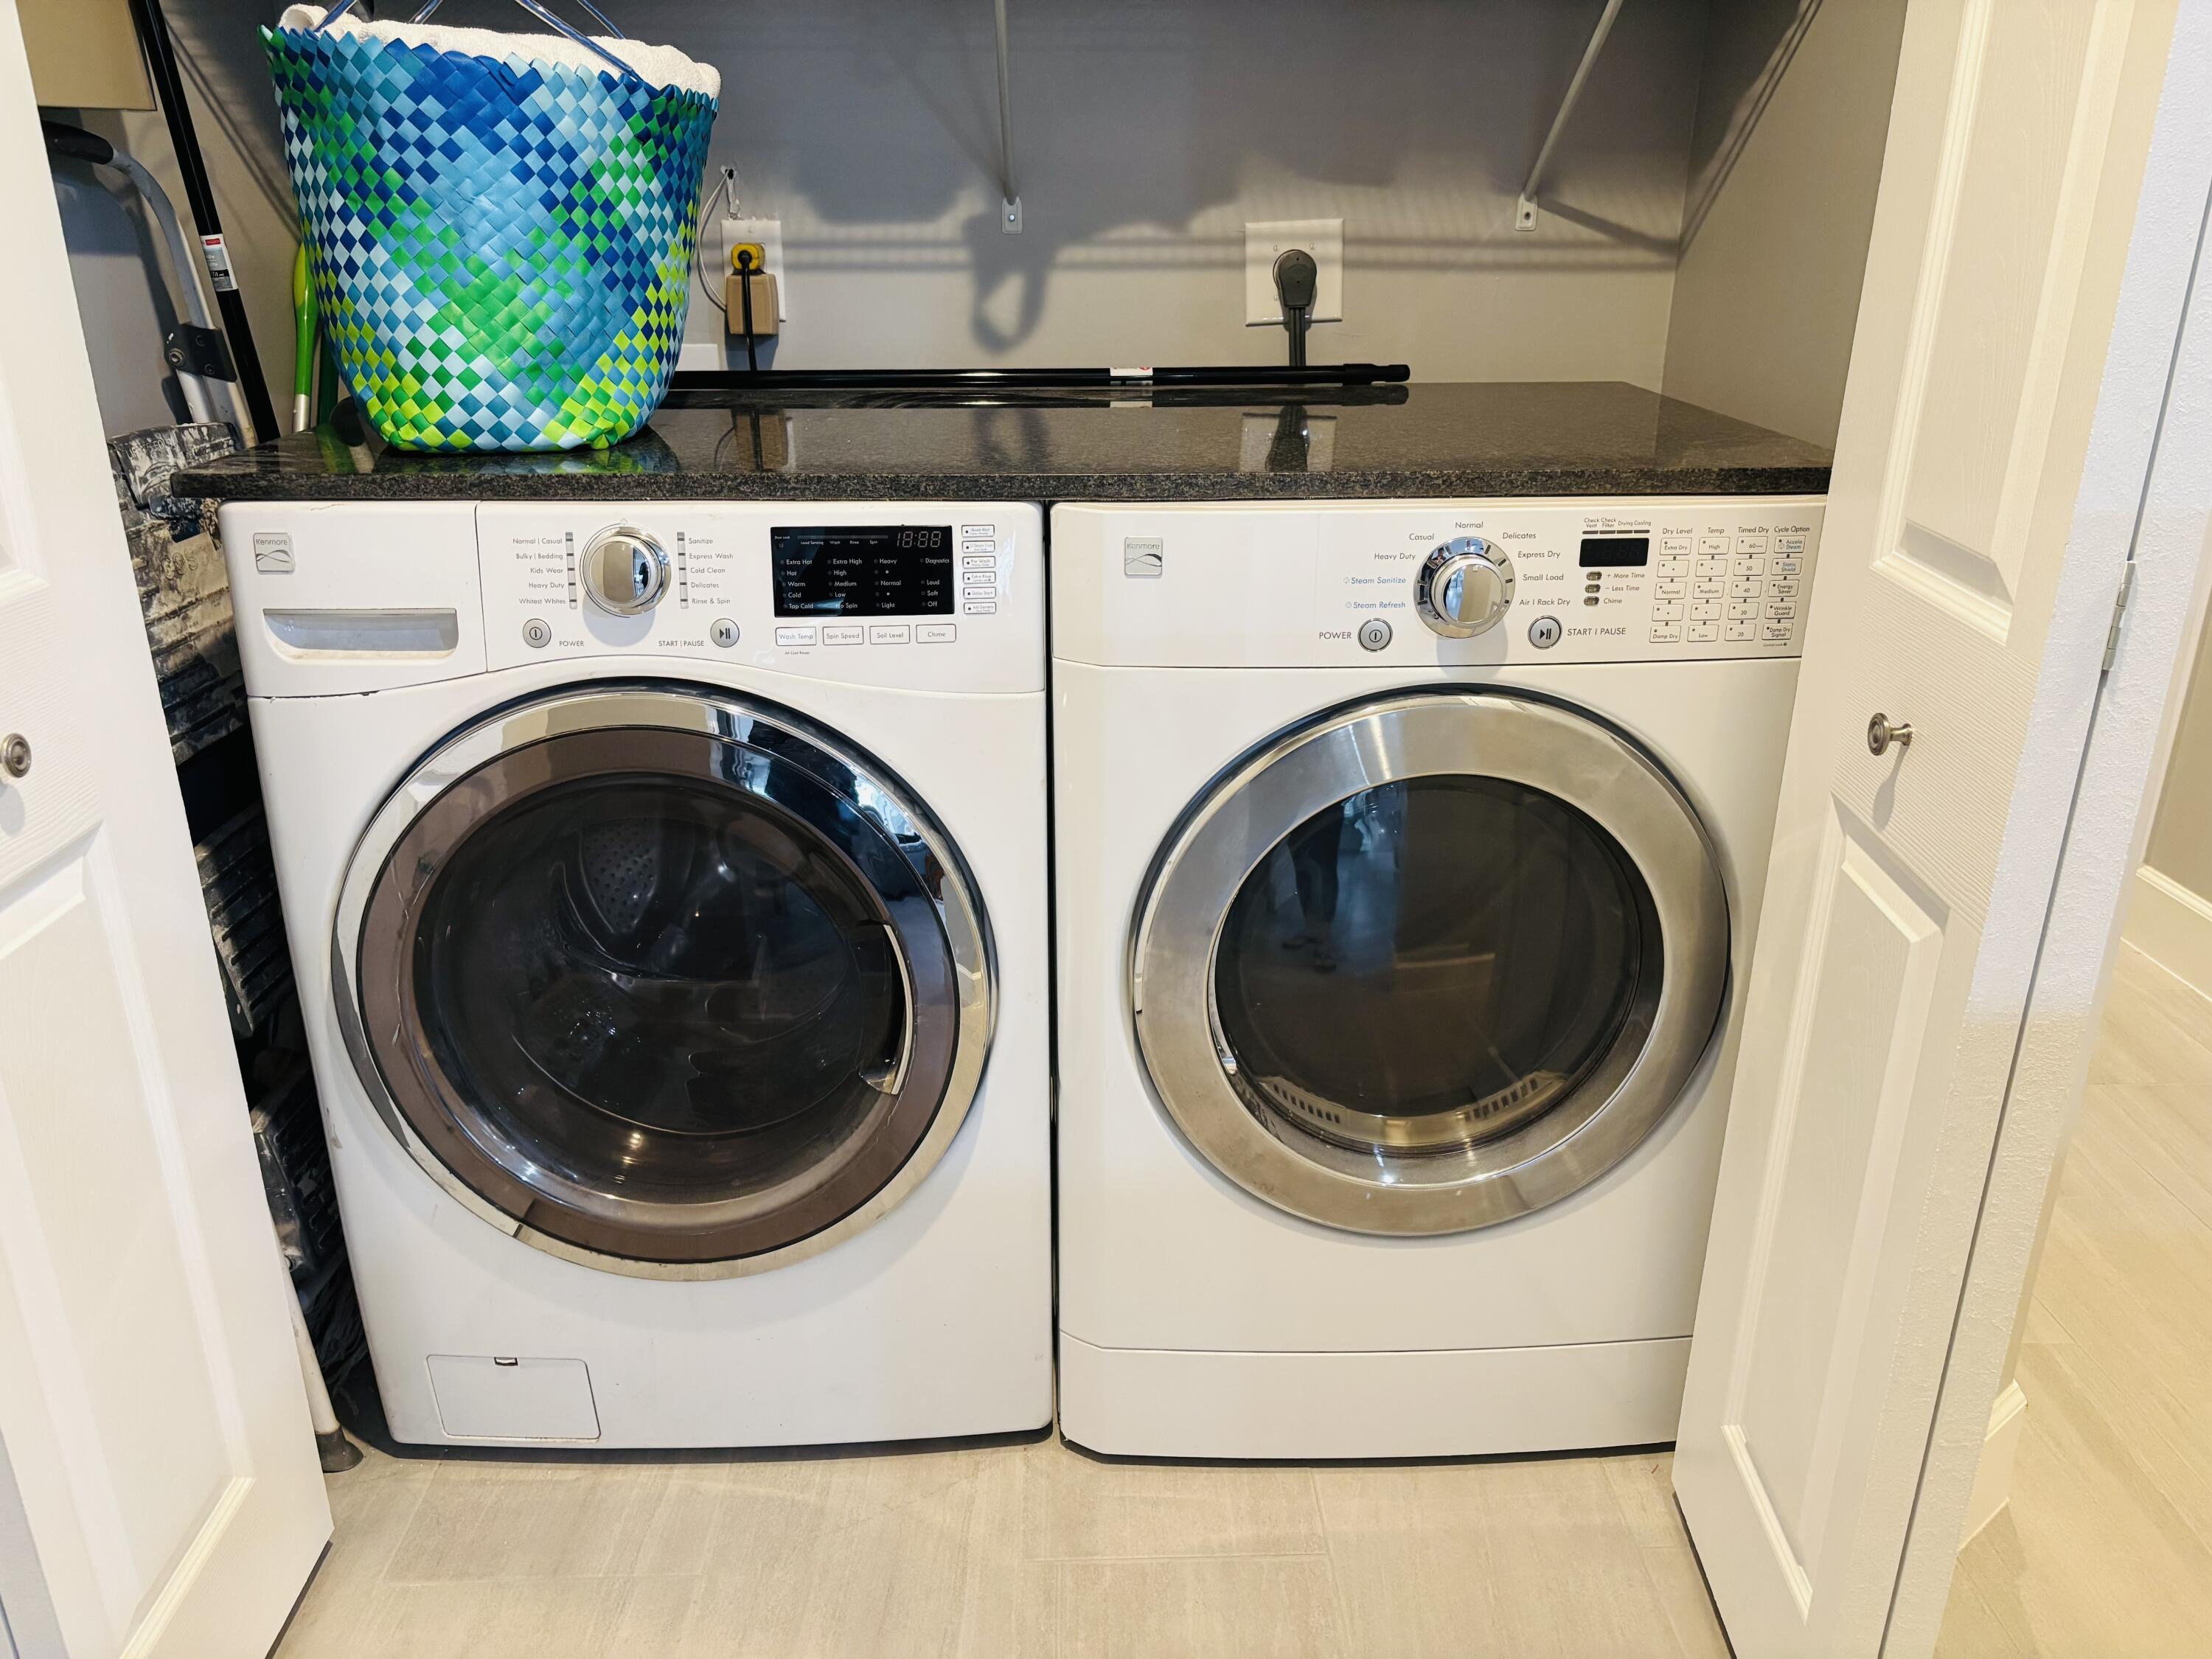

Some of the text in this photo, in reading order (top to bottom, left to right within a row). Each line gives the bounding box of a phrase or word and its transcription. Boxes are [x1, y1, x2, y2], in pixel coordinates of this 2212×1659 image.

[1455, 521, 1484, 529] Normal
[1374, 553, 1397, 561] Heavy
[1517, 550, 1561, 560] Express Dry
[1557, 598, 1571, 606] Dry
[1319, 631, 1352, 639] POWER
[1567, 628, 1592, 636] START
[1600, 627, 1627, 636] PAUSE
